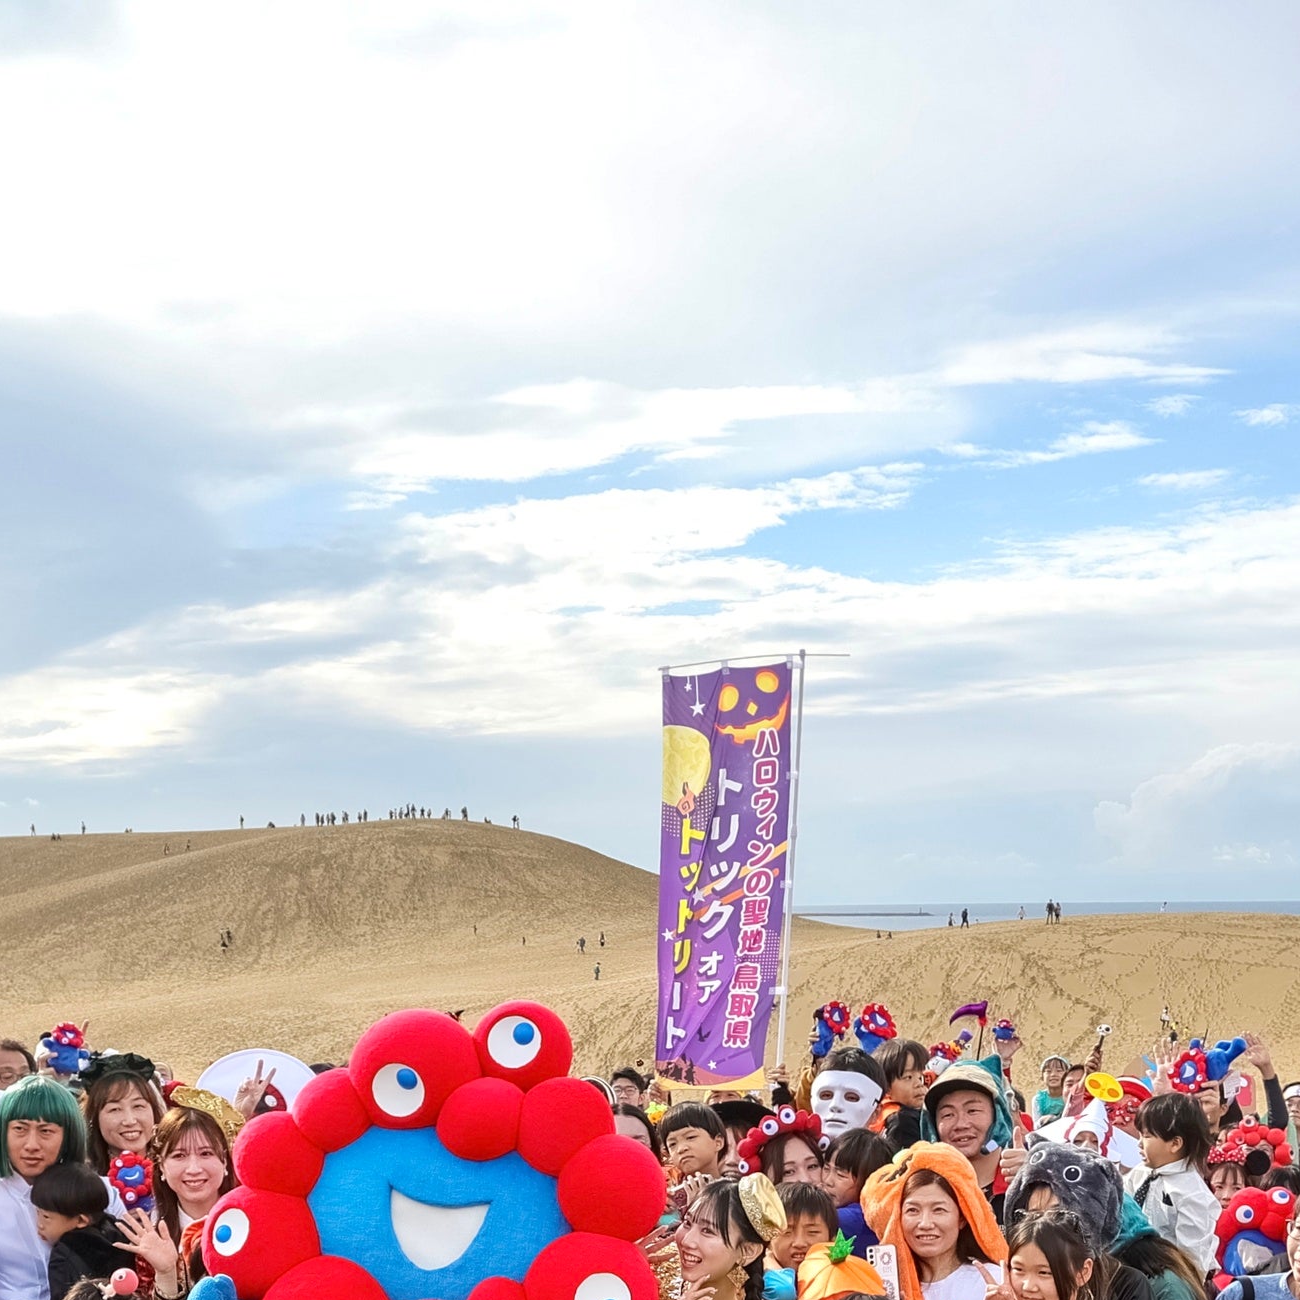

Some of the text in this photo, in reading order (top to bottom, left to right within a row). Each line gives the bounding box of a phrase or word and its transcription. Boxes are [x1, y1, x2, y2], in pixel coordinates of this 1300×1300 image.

[665, 817, 706, 1049] トットリート
[722, 962, 761, 1048] 鳥取県
